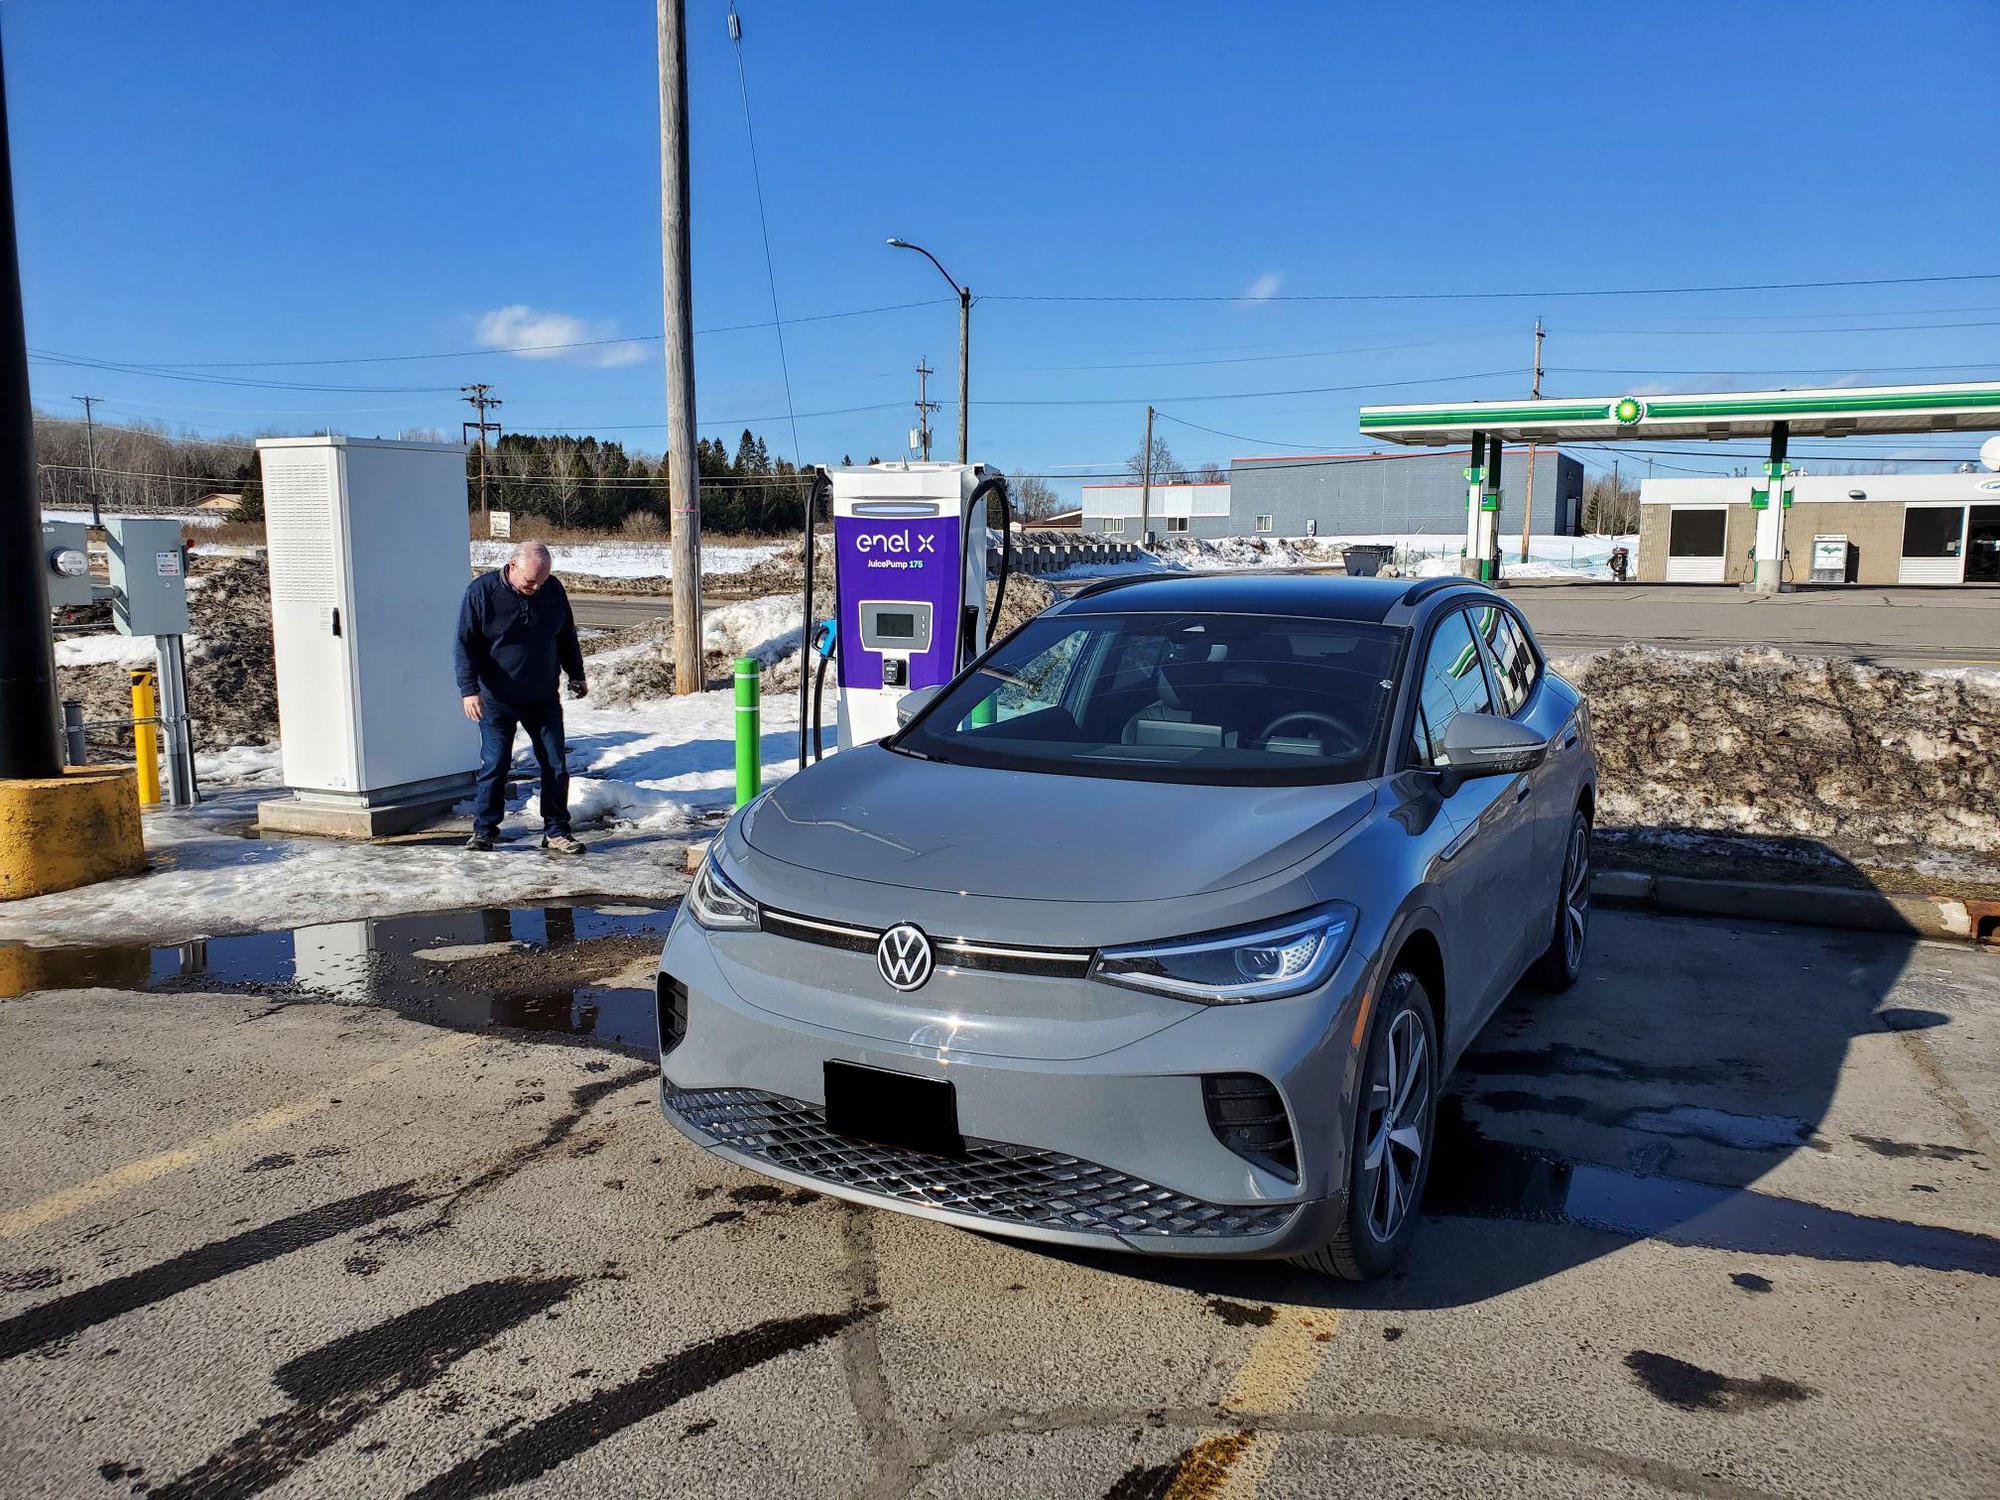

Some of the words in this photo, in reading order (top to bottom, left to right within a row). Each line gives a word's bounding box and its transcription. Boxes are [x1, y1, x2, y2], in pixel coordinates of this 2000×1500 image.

[856, 529, 910, 552] enel
[868, 560, 907, 570] JuicePump
[909, 560, 923, 568] 175
[878, 926, 931, 989] VW
